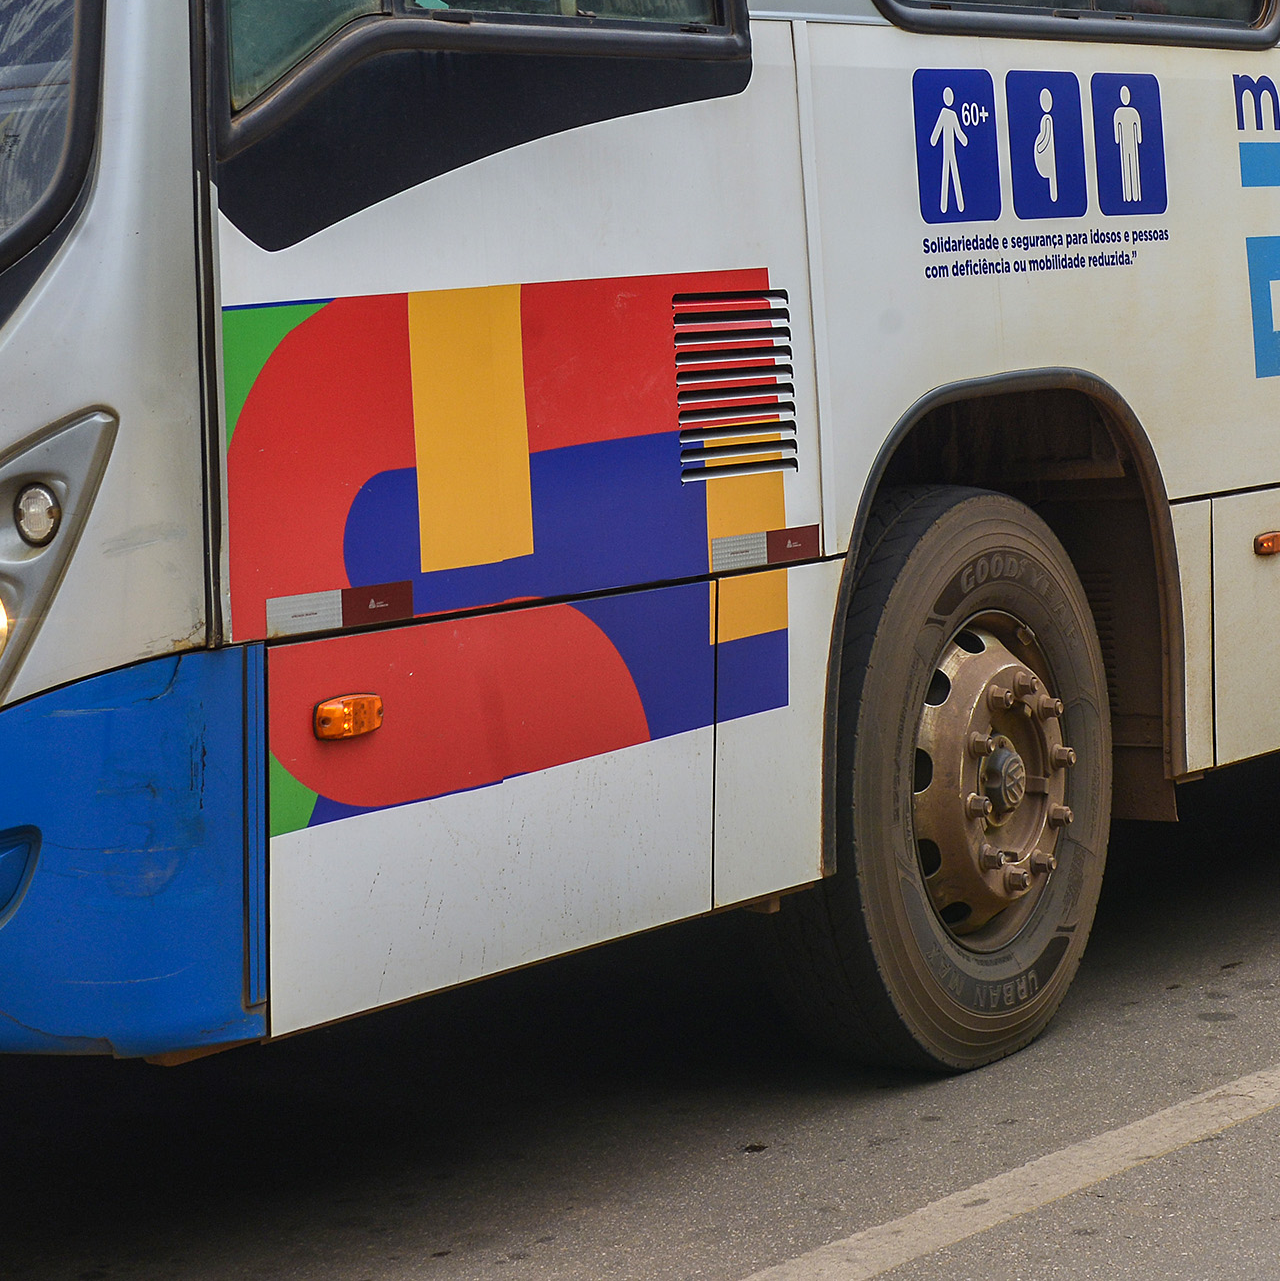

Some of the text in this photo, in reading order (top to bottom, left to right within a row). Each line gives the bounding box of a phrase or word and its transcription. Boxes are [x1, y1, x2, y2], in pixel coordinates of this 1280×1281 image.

[961, 102, 989, 127] 60+
[922, 228, 1169, 254] Solidariedade e segurança para idosos e pessoas
[924, 264, 950, 279] com
[951, 257, 1011, 277] deficiência
[1013, 259, 1027, 273] ou
[1028, 252, 1086, 272] mobilidade
